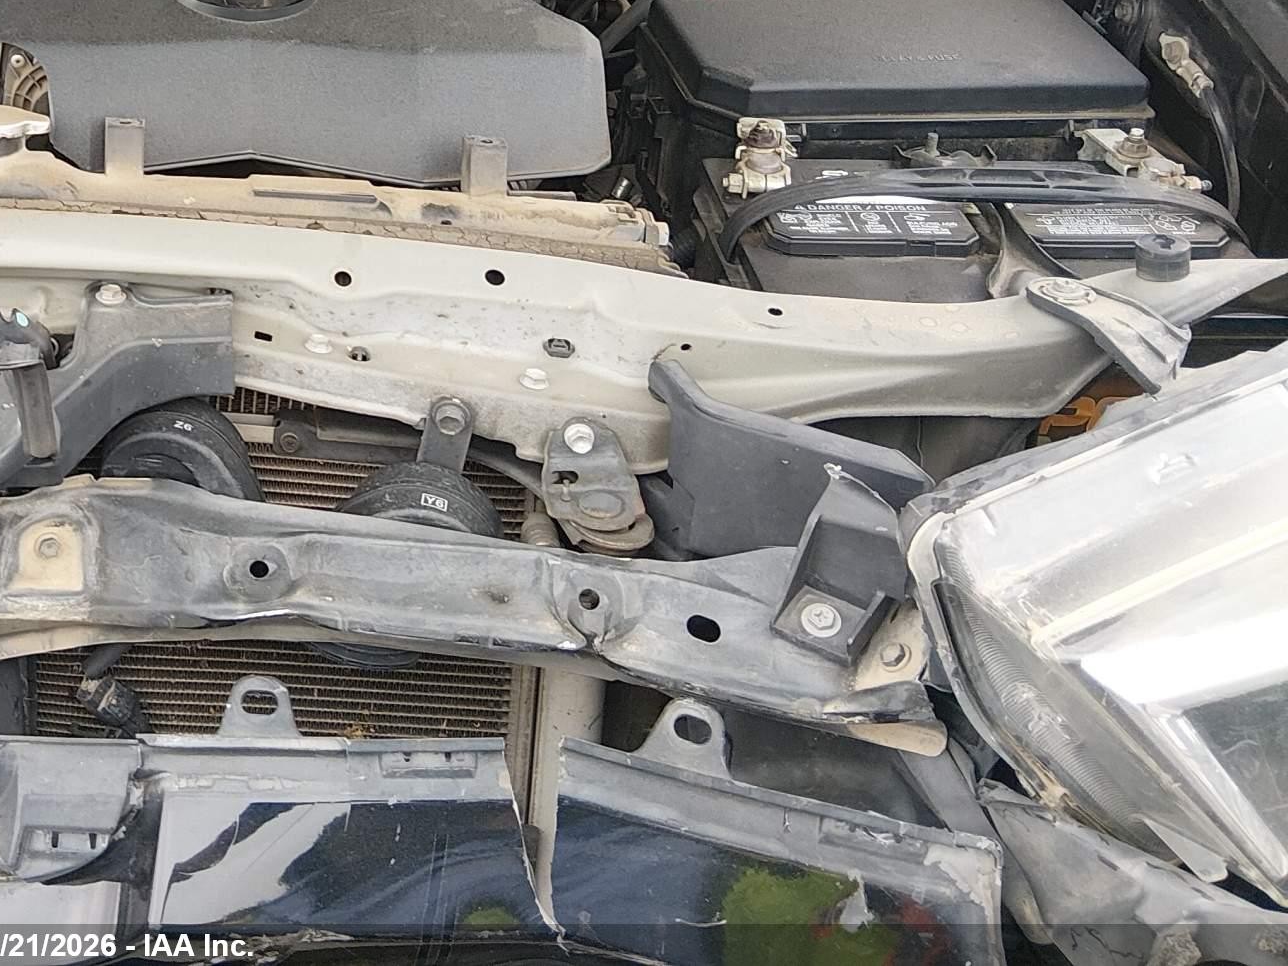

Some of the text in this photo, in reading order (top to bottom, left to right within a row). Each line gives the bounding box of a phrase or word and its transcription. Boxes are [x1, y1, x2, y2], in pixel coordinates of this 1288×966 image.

[807, 203, 865, 212] DANGER
[873, 204, 927, 212] POISON
[173, 419, 194, 432] Z6
[423, 495, 447, 510] Y6
